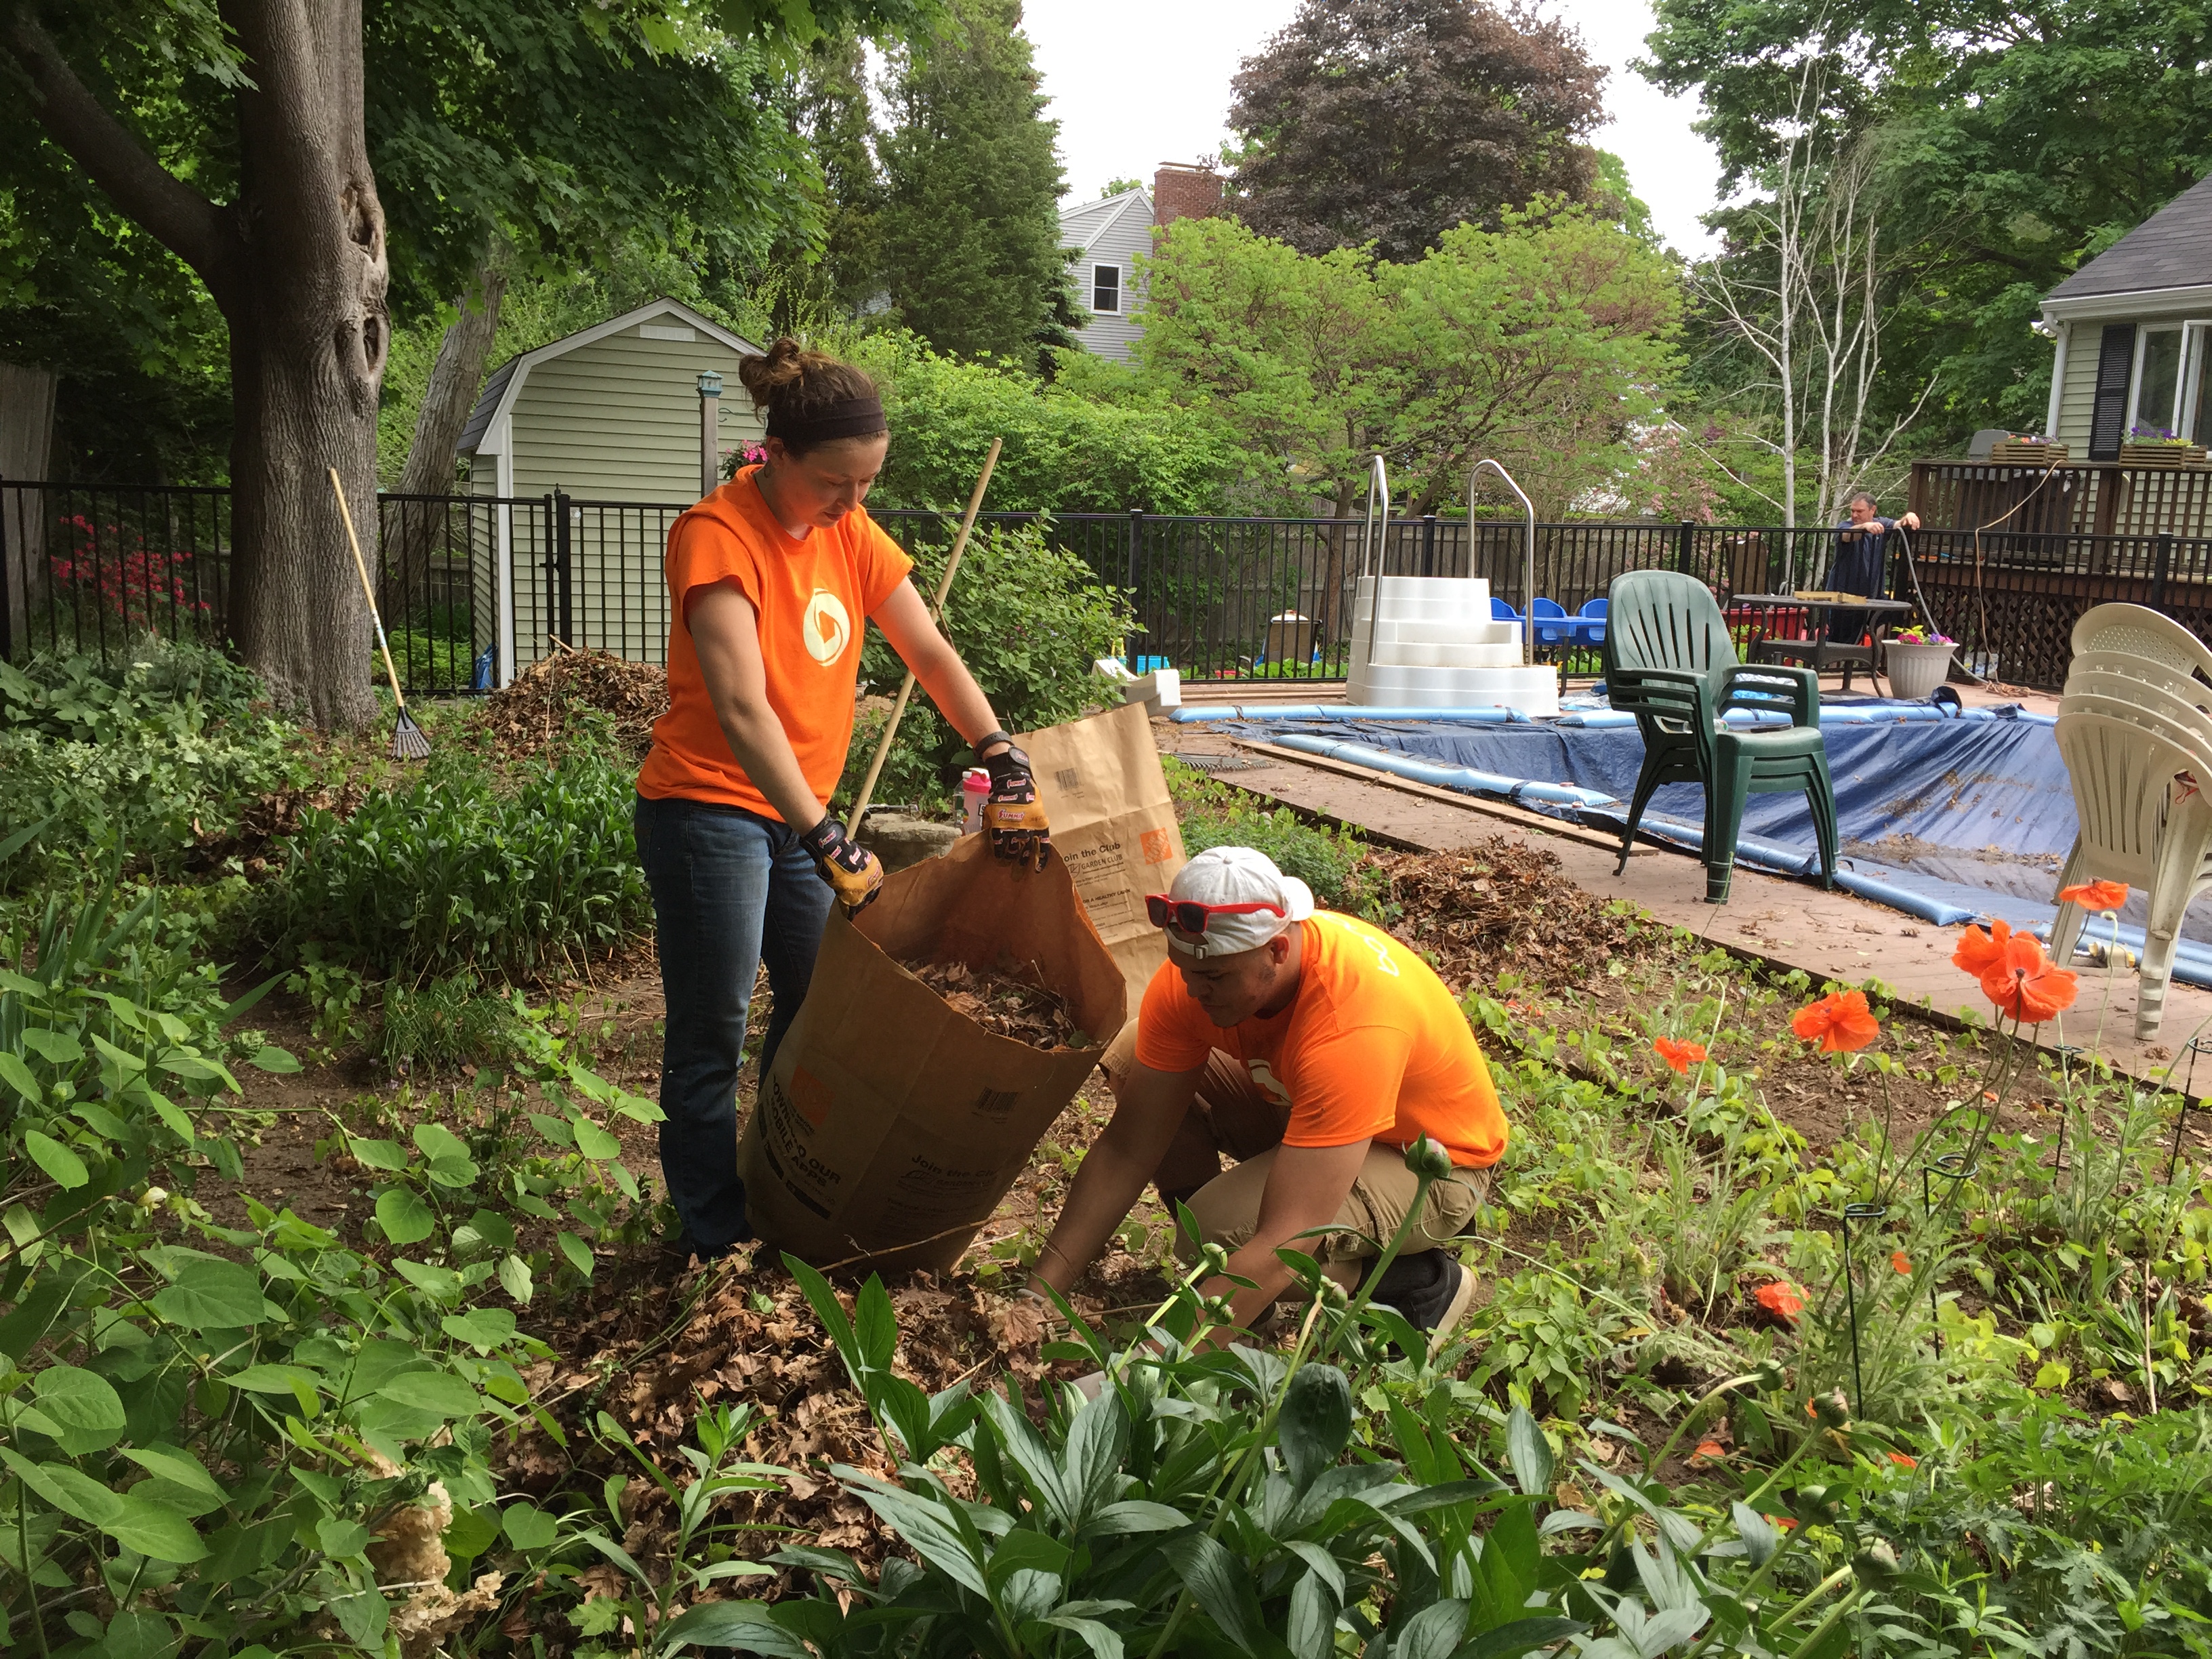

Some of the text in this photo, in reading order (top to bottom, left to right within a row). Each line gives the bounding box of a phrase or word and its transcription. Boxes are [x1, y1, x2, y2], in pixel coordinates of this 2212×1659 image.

[998, 809, 1024, 820] SUMMIT
[1064, 842, 1121, 862] oin the Club
[1081, 858, 1106, 869] GARDEN
[1107, 854, 1123, 863] CLUB
[792, 1155, 827, 1187] APPS
[809, 1158, 841, 1185] OUR
[912, 1154, 942, 1174] Join
